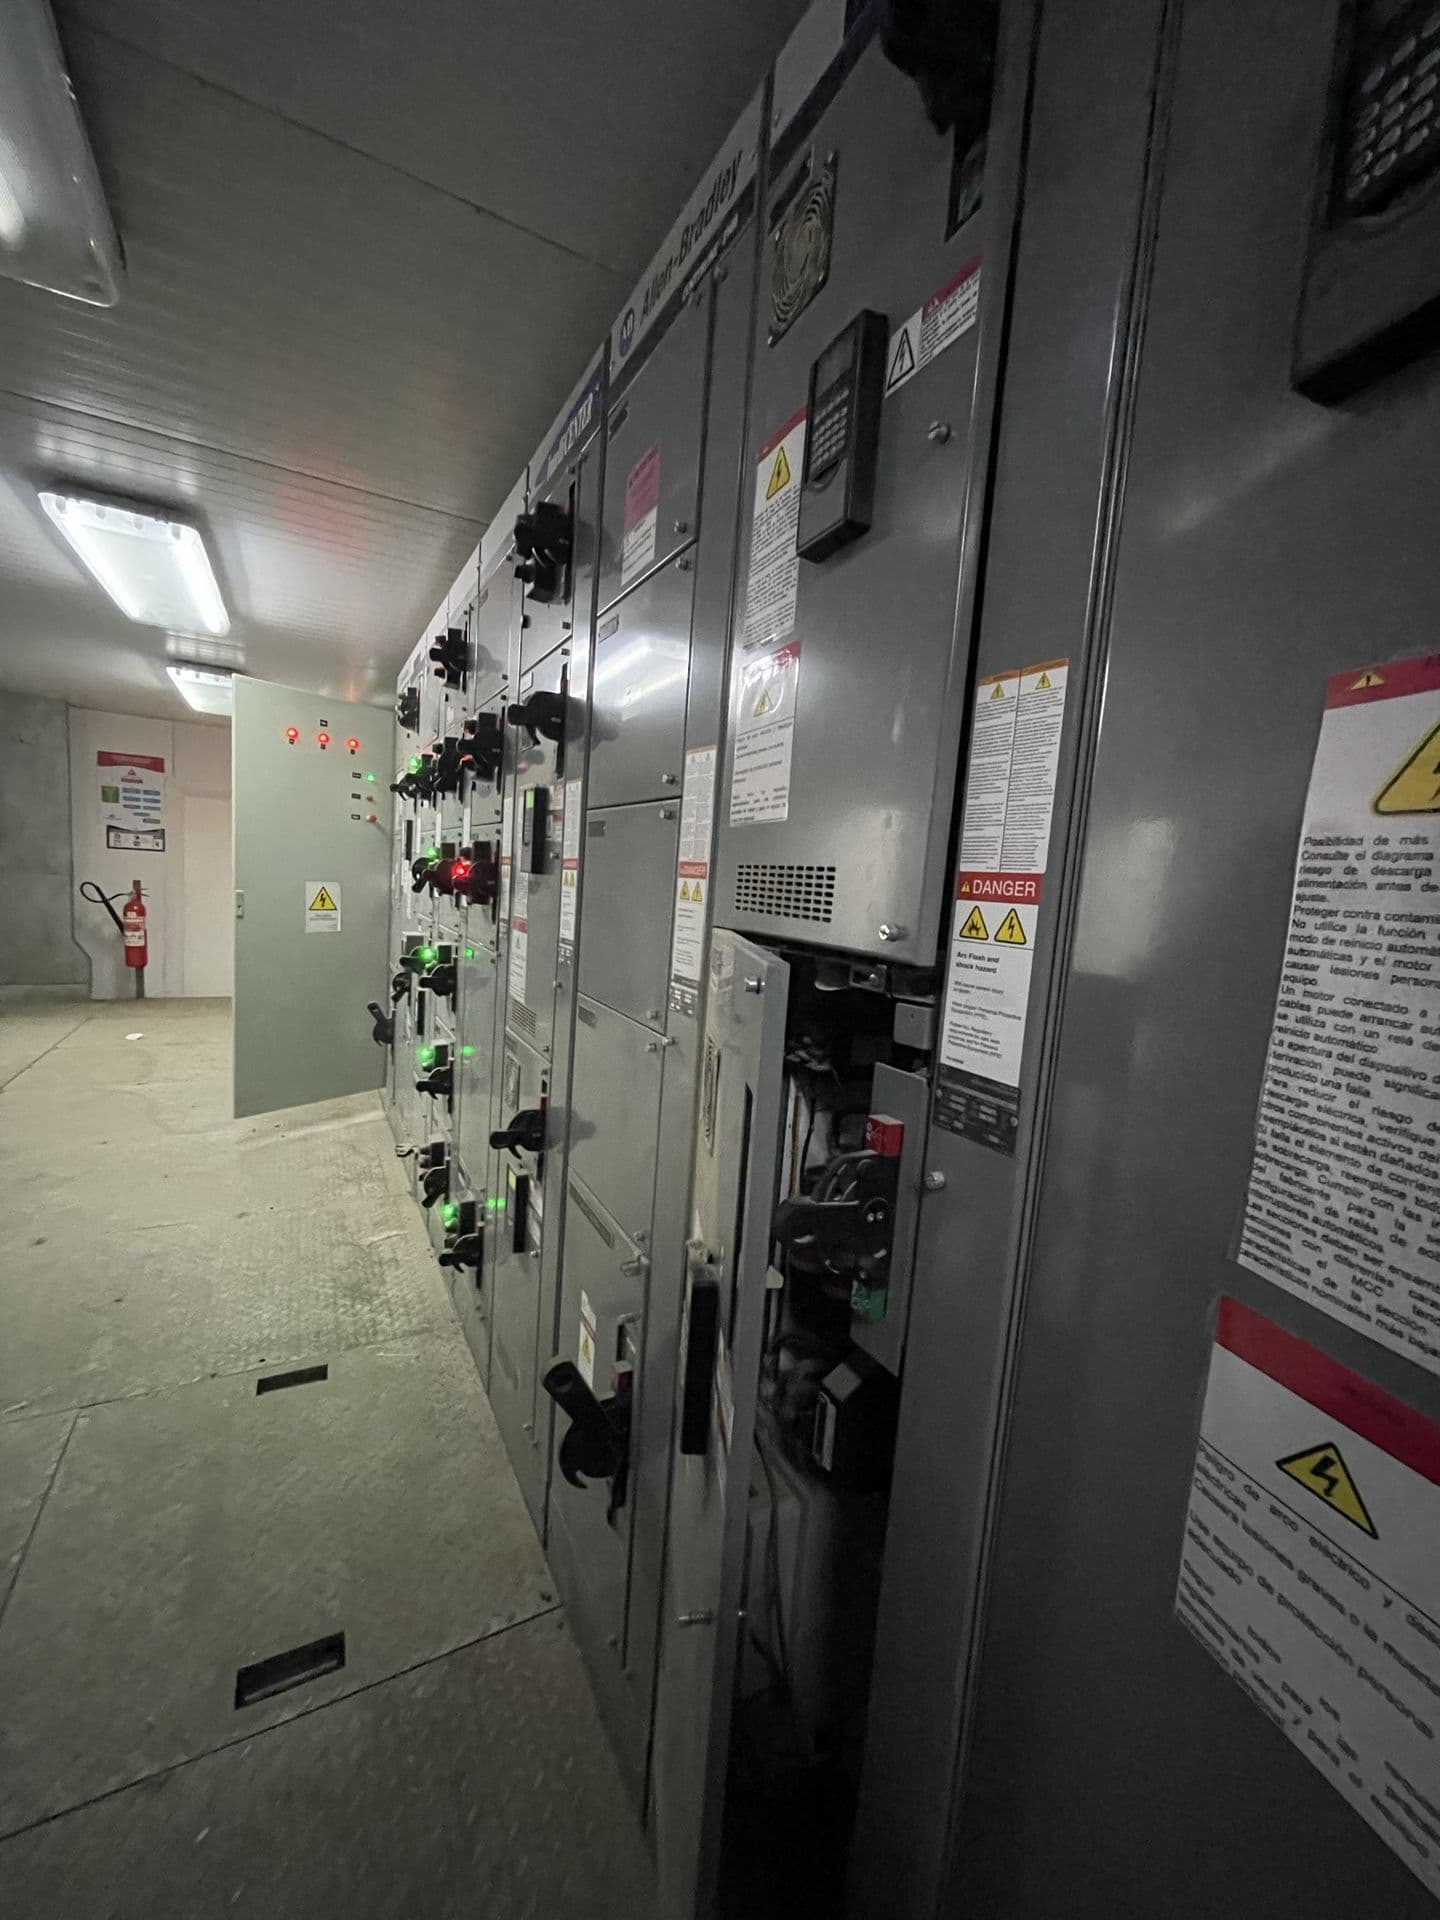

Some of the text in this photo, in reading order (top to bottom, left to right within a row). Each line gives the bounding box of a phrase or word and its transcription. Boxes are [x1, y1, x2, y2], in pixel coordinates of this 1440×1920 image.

[640, 150, 743, 326] Allen-Bradley
[1304, 835, 1428, 845] Posibilidad de más
[1301, 850, 1433, 862] Consulte el diagrama
[1299, 865, 1431, 878] riesgo de descarga
[972, 879, 1036, 897] DANGER
[1297, 878, 1438, 892] alimentación antes de
[1295, 893, 1328, 902] ajuste.
[1293, 906, 1338, 917] Proteger
[1343, 910, 1379, 920] contra
[1292, 919, 1306, 928] No
[1314, 922, 1346, 932] utilice
[1355, 924, 1367, 934] la
[1377, 925, 1425, 939] función
[1289, 934, 1318, 943] modo
[1321, 936, 1335, 945] de
[1339, 939, 1381, 950] reinicio
[956, 962, 997, 974] shock hazard
[969, 953, 986, 961] Flash
[1288, 947, 1431, 971] automáticas y el motor
[1285, 961, 1319, 971] causar
[1330, 965, 1379, 980] lesiones
[1281, 984, 1427, 1018] Un motor conectado a
[1279, 999, 1412, 1030] cables puede arrancar
[1275, 1025, 1310, 1038] reinicio
[1295, 1015, 1325, 1028] utiliza
[1334, 1023, 1355, 1033] con
[1363, 1029, 1379, 1038] un
[1387, 1034, 1413, 1046] relé
[1271, 1035, 1284, 1047] La
[1287, 1041, 1332, 1058] apertura
[1336, 1051, 1355, 1063] del
[1359, 1057, 1427, 1080] dispositivo
[1320, 1077, 1341, 1090] una
[1332, 1067, 1371, 1082] puede
[1298, 1086, 1336, 1102] reducir
[1348, 1100, 1359, 1109] el
[1372, 1106, 1412, 1124] riesgo
[1262, 1101, 1284, 1114] otros
[1288, 1109, 1362, 1139] componentes
[1367, 1134, 1412, 1155] activos
[1378, 1123, 1435, 1146] verifique
[1270, 1128, 1290, 1143] falla
[1294, 1139, 1304, 1148] el
[1309, 1144, 1360, 1168] elemento
[1367, 1164, 1382, 1176] de
[1329, 1136, 1339, 1146] si
[1343, 1141, 1375, 1158] están
[1256, 1137, 1267, 1148] de
[1341, 1170, 1406, 1200] reemplace
[1252, 1162, 1405, 1231] del fabricante para la
[1318, 1174, 1362, 1198] Cumplir
[1370, 1196, 1393, 1211] con
[1403, 1206, 1421, 1222] las
[1251, 1175, 1314, 1207] configuración
[1324, 1206, 1338, 1218] de
[1348, 1216, 1378, 1235] relés
[1389, 1233, 1406, 1247] de
[1266, 1209, 1316, 1237] secciones
[1321, 1234, 1357, 1255] deben
[1301, 1239, 1321, 1252] con
[1334, 1254, 1393, 1287] diferentes
[1316, 1260, 1327, 1269] el
[1351, 1275, 1383, 1296] MCC
[1322, 1276, 1337, 1289] de
[1351, 1290, 1361, 1301] la
[1311, 1285, 1370, 1321] nominales
[1375, 1319, 1403, 1338] más
[1269, 1505, 1297, 1531] arco
[1309, 1536, 1369, 1589] eléctrico
